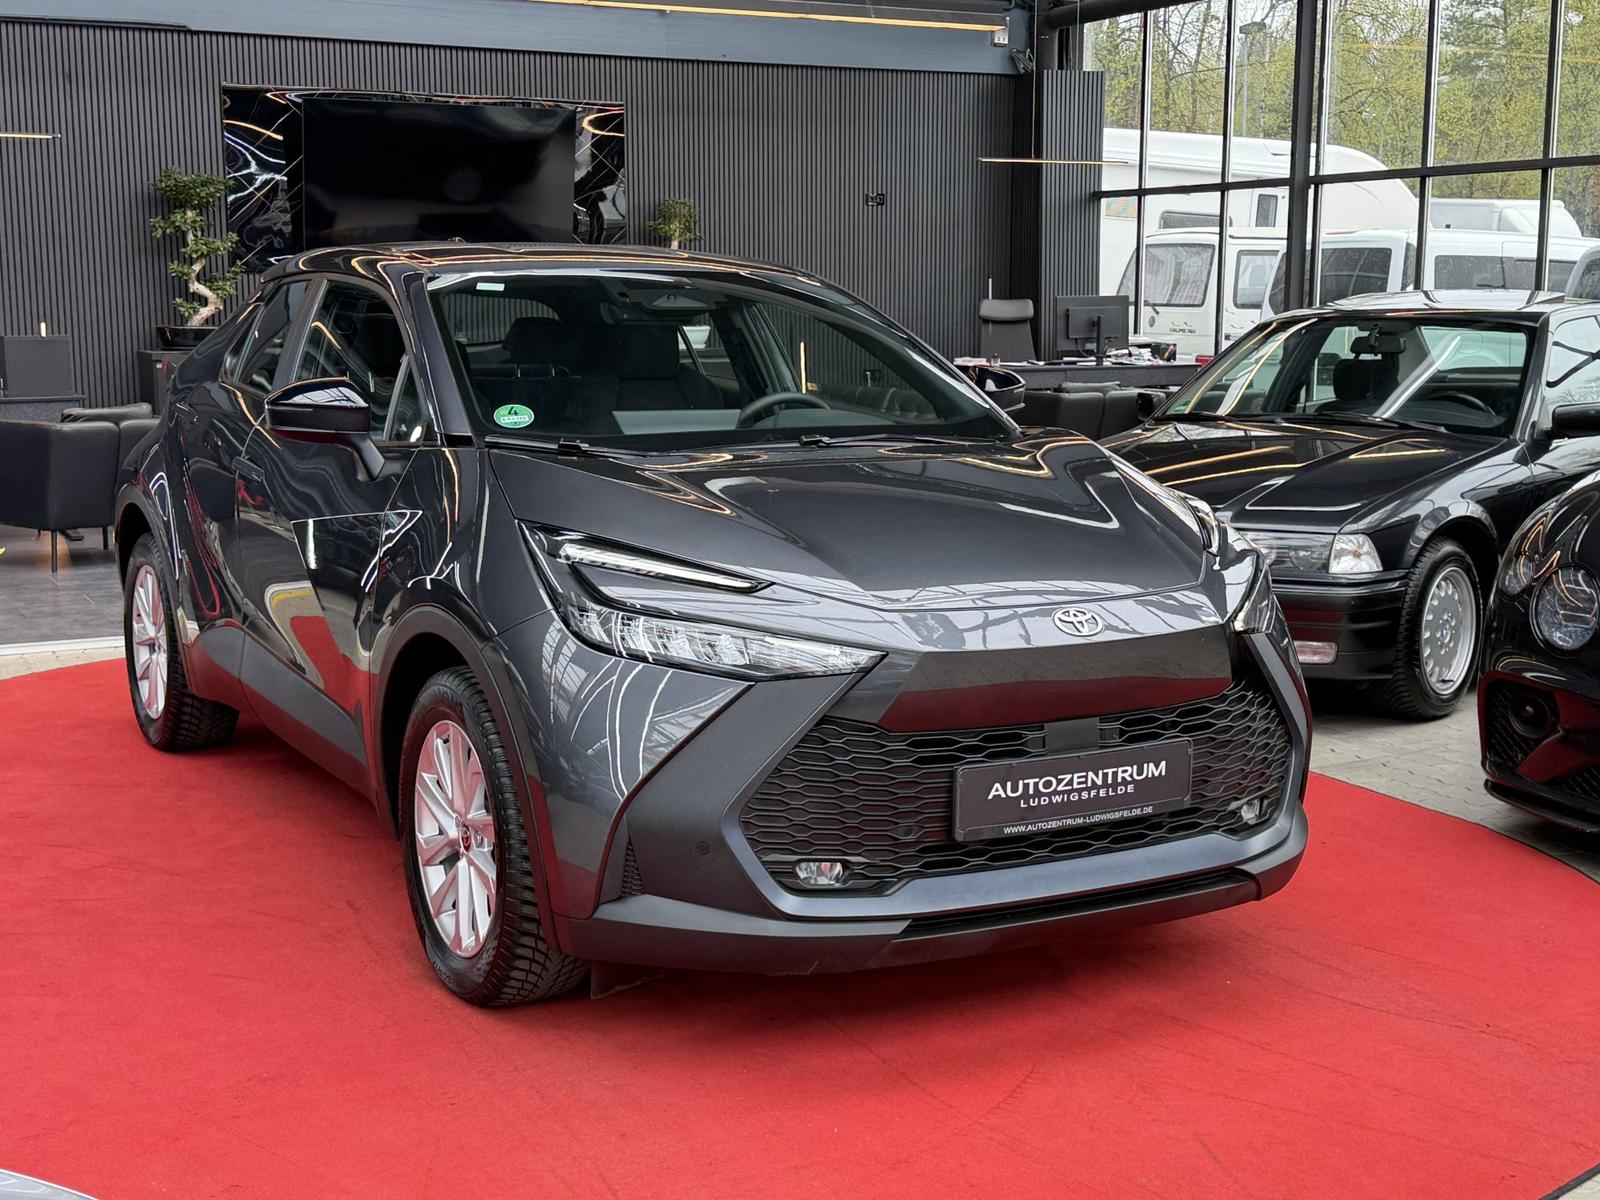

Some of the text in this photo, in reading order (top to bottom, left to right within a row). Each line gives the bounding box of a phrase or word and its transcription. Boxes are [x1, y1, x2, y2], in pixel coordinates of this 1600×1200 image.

[508, 406, 518, 416] 4
[987, 760, 1167, 800] AUTOZENTRUM
[1020, 784, 1135, 808] LUDWIGSFELDE
[1003, 806, 1153, 834] WWW.AUTOZENTRUM-LUDWIGSFELDE.DE
